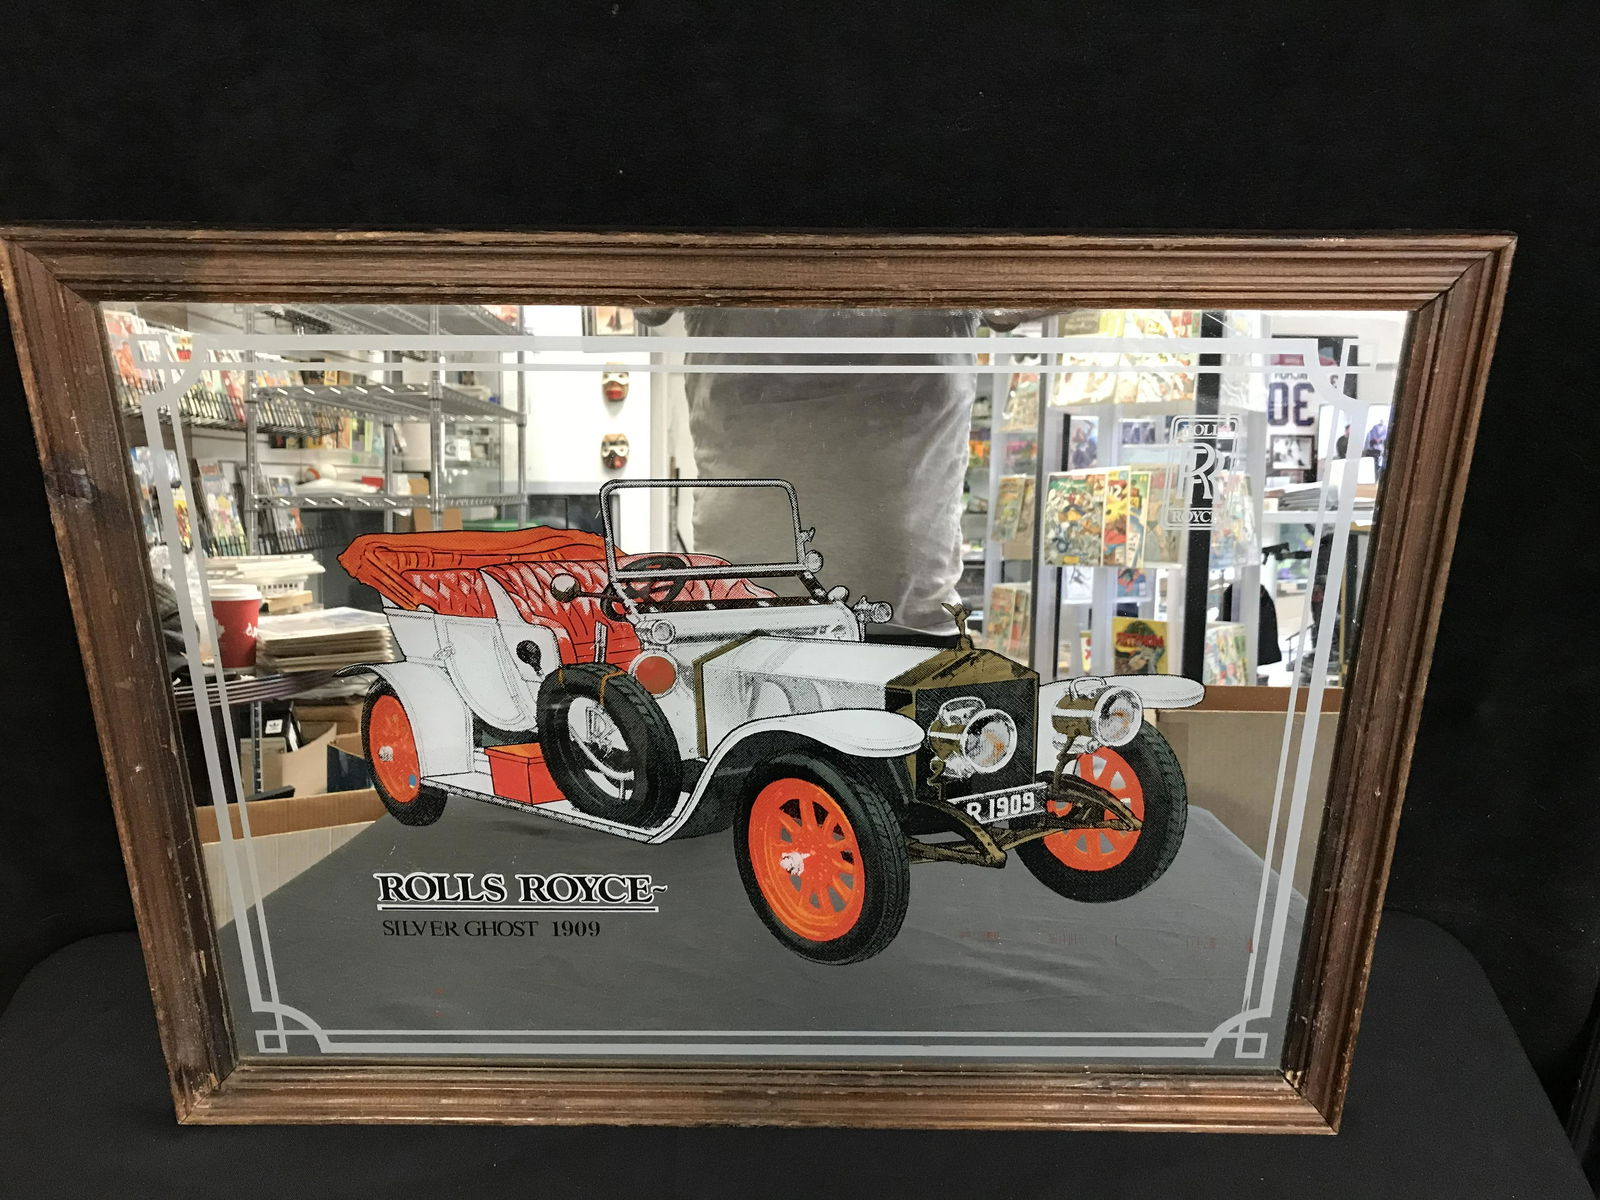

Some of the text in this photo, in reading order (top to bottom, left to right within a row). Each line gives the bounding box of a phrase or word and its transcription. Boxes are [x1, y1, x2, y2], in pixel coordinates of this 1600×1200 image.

[1183, 423, 1229, 436] OLL
[1172, 510, 1219, 523] ROYC
[989, 792, 1035, 819] 1909
[373, 872, 508, 903] ROLLS
[383, 919, 601, 938] SILVER GHOST 1909
